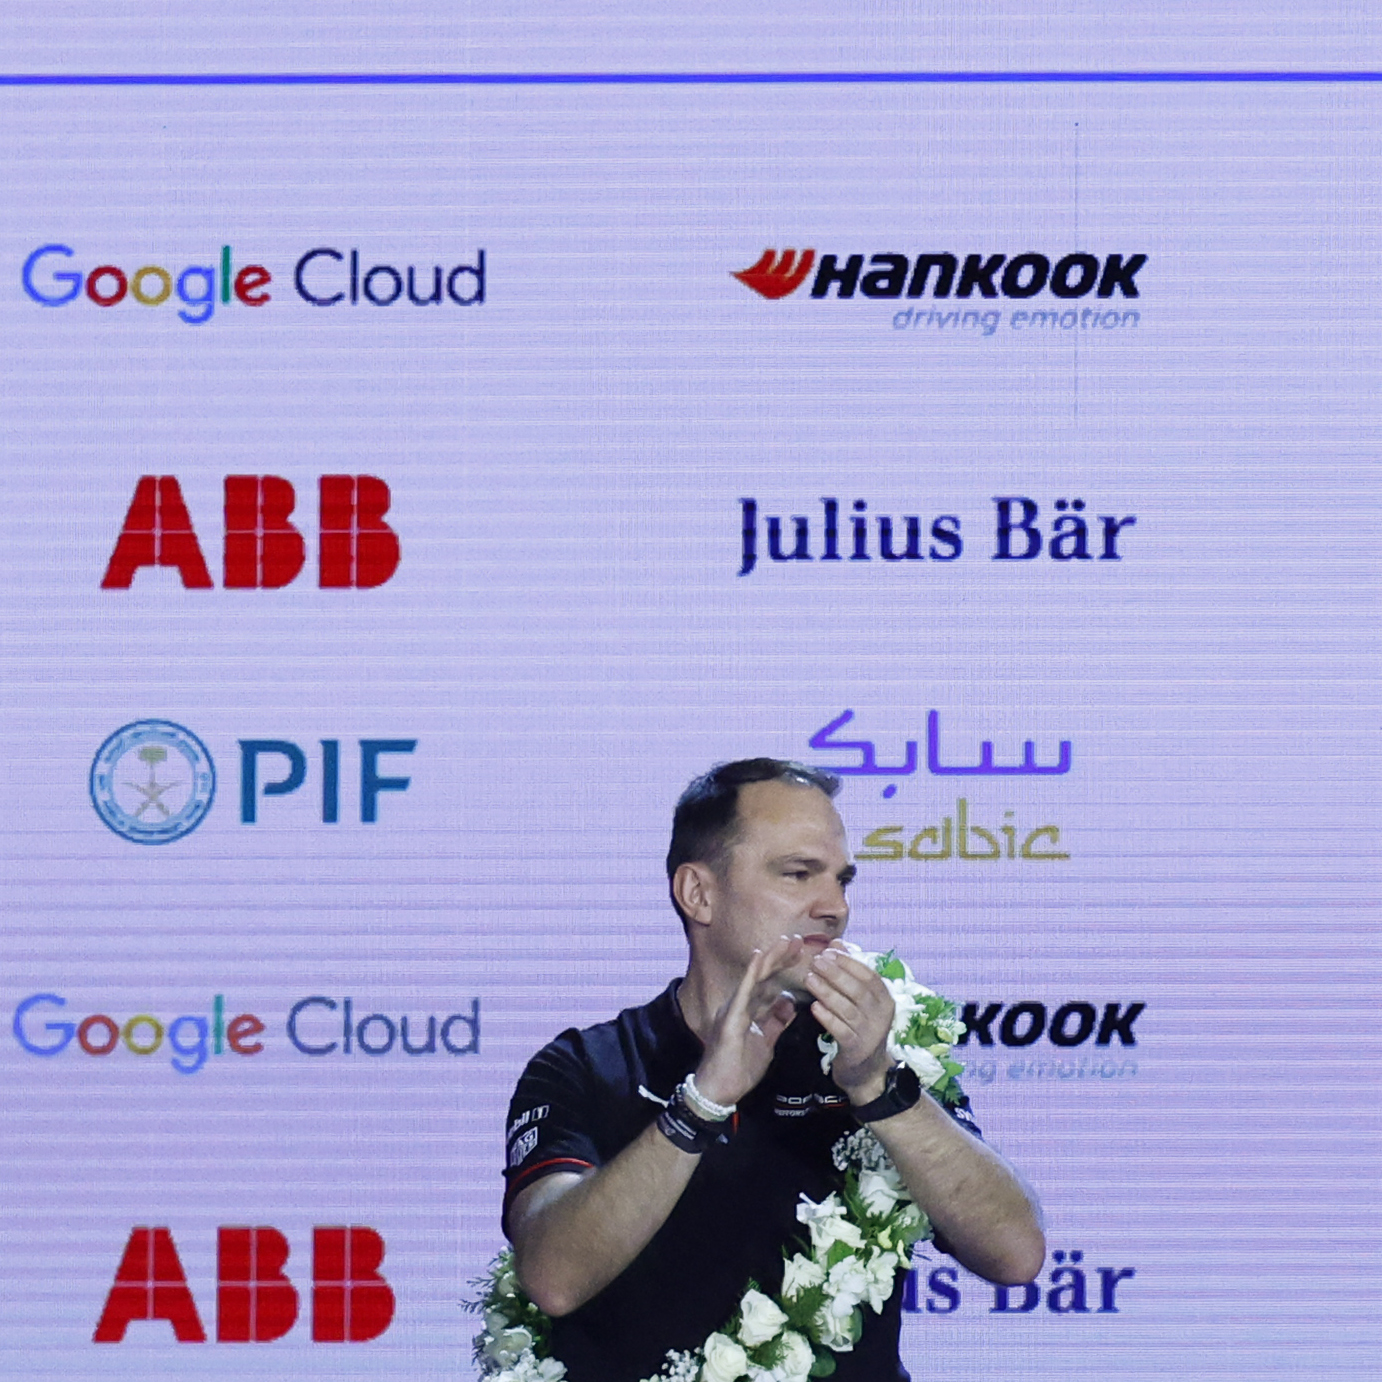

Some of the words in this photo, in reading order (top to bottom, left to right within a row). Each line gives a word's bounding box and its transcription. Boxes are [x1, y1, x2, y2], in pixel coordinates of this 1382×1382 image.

[22, 244, 272, 324] Google
[294, 250, 487, 307] Cloud
[892, 307, 1001, 336] driving
[1009, 307, 1141, 330] emotion
[100, 475, 402, 590] ABB
[736, 498, 965, 577] Julius
[991, 496, 1138, 562] Bär
[237, 739, 420, 825] PIF
[12, 992, 266, 1074] Google
[286, 996, 481, 1055] Cloud
[954, 1002, 1147, 1048] KOOK
[91, 1225, 396, 1344] ABB
